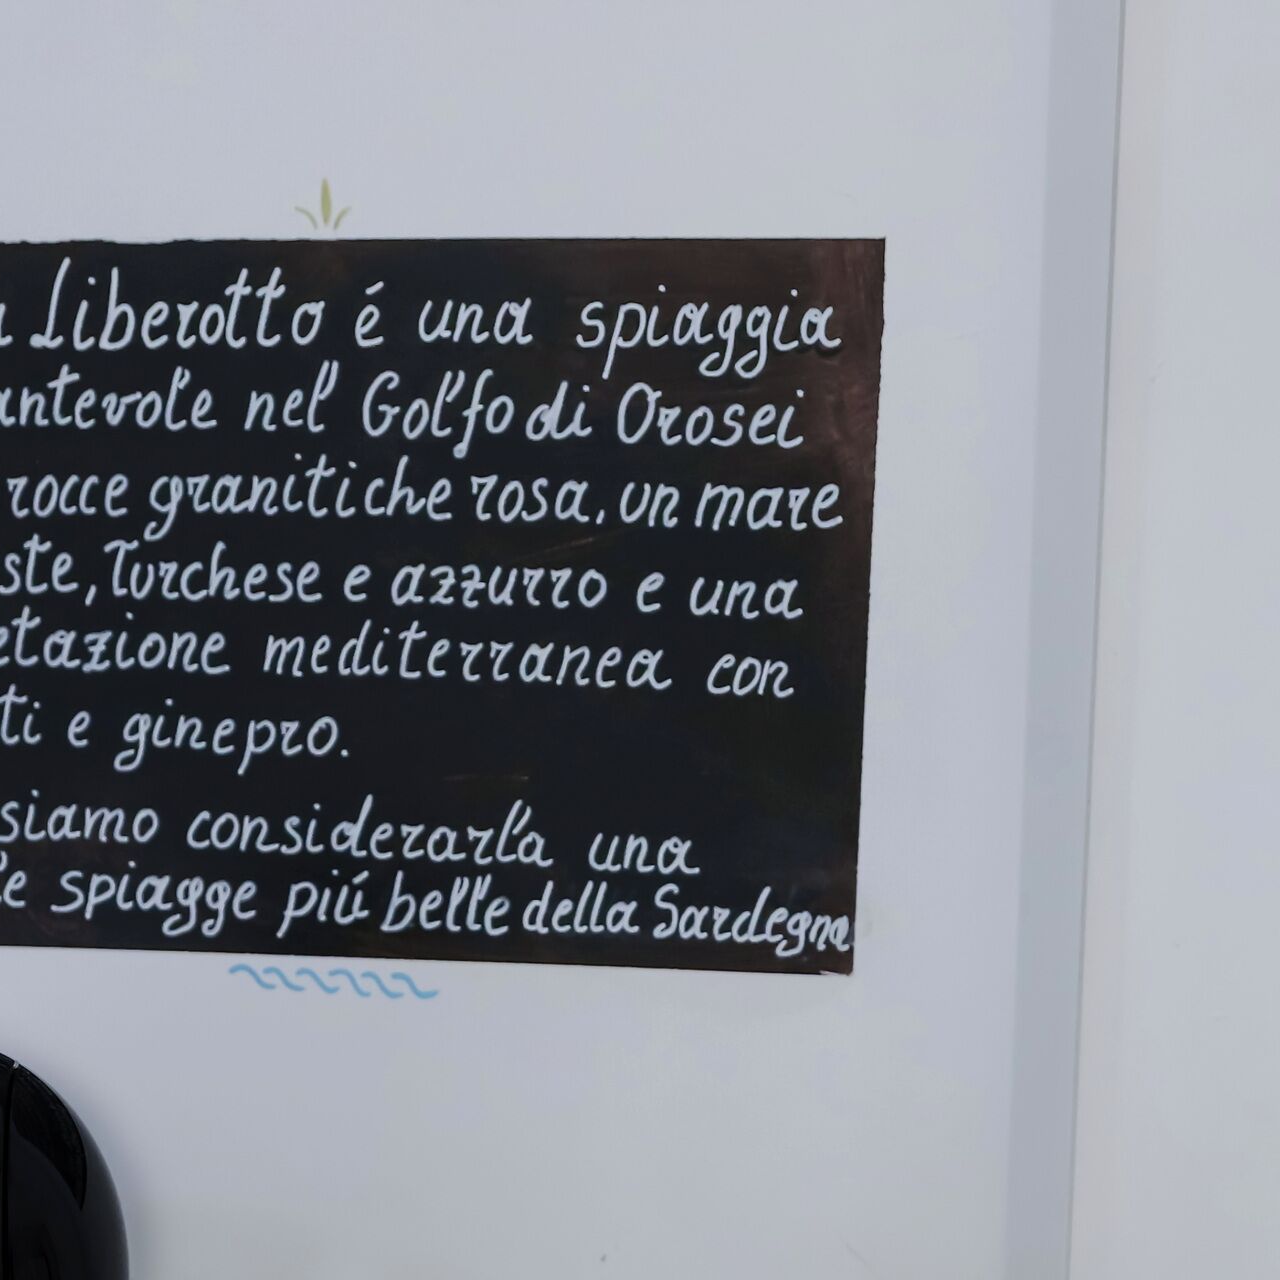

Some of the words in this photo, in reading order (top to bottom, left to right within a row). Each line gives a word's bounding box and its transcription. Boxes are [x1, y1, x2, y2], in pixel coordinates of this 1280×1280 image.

[30, 256, 326, 351] Liberotto
[354, 280, 384, 348] é
[418, 296, 533, 346] una
[575, 283, 842, 380] spiaggia
[243, 359, 339, 433] nel
[362, 368, 515, 459] Golfo
[524, 380, 592, 442] di
[616, 381, 805, 449] Orosei
[6, 472, 129, 517] rocce
[144, 452, 453, 542] granitiche
[619, 480, 678, 529] un
[694, 480, 844, 532] mare
[103, 539, 322, 604] Turchese
[343, 564, 370, 601] e
[390, 562, 608, 608] azzurro
[636, 571, 665, 613] e
[688, 577, 804, 620] una
[262, 618, 673, 692] mediterranea
[706, 652, 795, 699] con
[67, 708, 93, 748] e
[113, 698, 350, 776] ginepro.
[186, 793, 554, 866] considerarla
[587, 832, 700, 876] una
[49, 860, 258, 939] spiagge
[381, 870, 510, 938] belle
[520, 879, 640, 938] della
